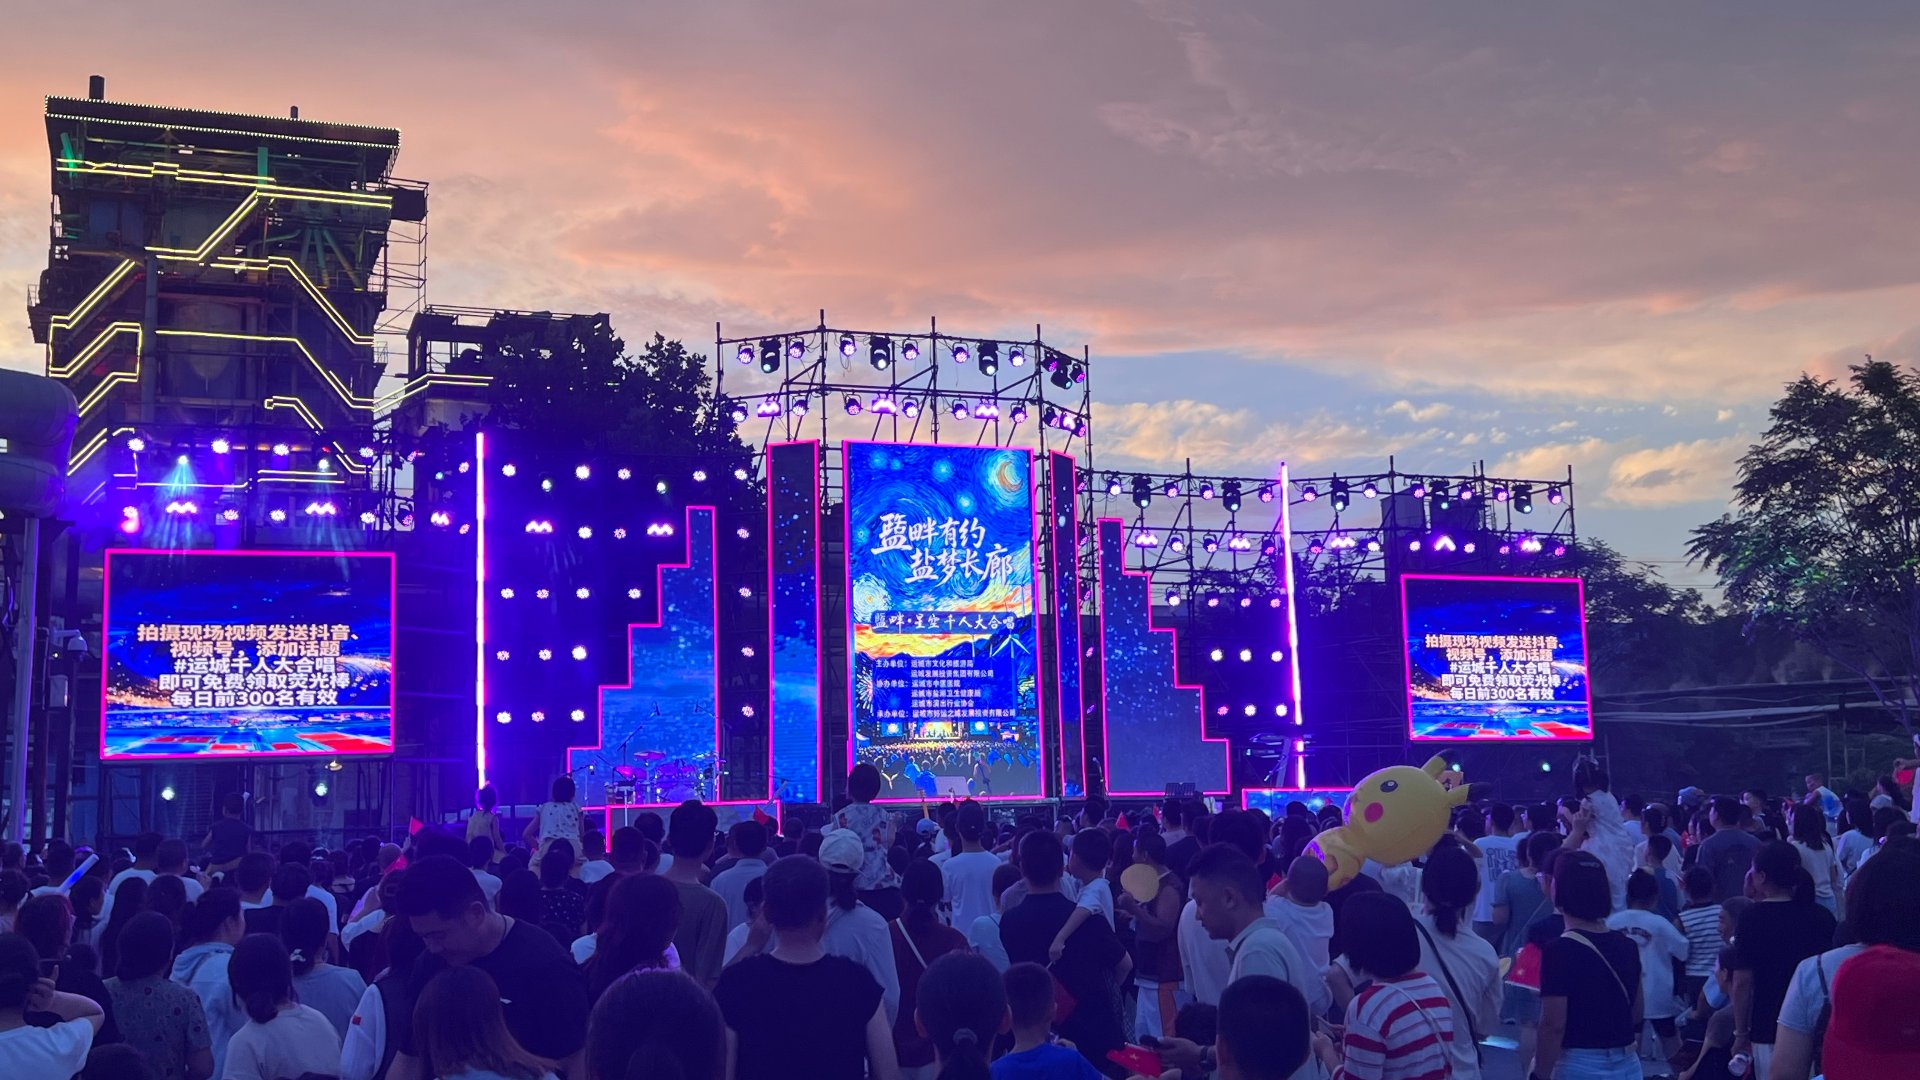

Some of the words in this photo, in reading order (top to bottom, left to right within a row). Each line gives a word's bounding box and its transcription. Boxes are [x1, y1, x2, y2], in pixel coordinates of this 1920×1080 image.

[904, 544, 1014, 589] 盐梦长廊
[137, 624, 359, 642] 拍摄现场视频发送抖音、
[1425, 635, 1564, 649] 拍摄现场视频发送抖音、
[174, 658, 335, 674] #运城千人大合唱
[1450, 661, 1550, 674] #运城千人大合唱
[159, 674, 350, 691] 即可免费领取荧光棒
[1441, 674, 1561, 687] 即可免费领取荧光棒
[171, 690, 338, 708] 每日前300名有效
[1450, 687, 1554, 701] 每日前300名有效
